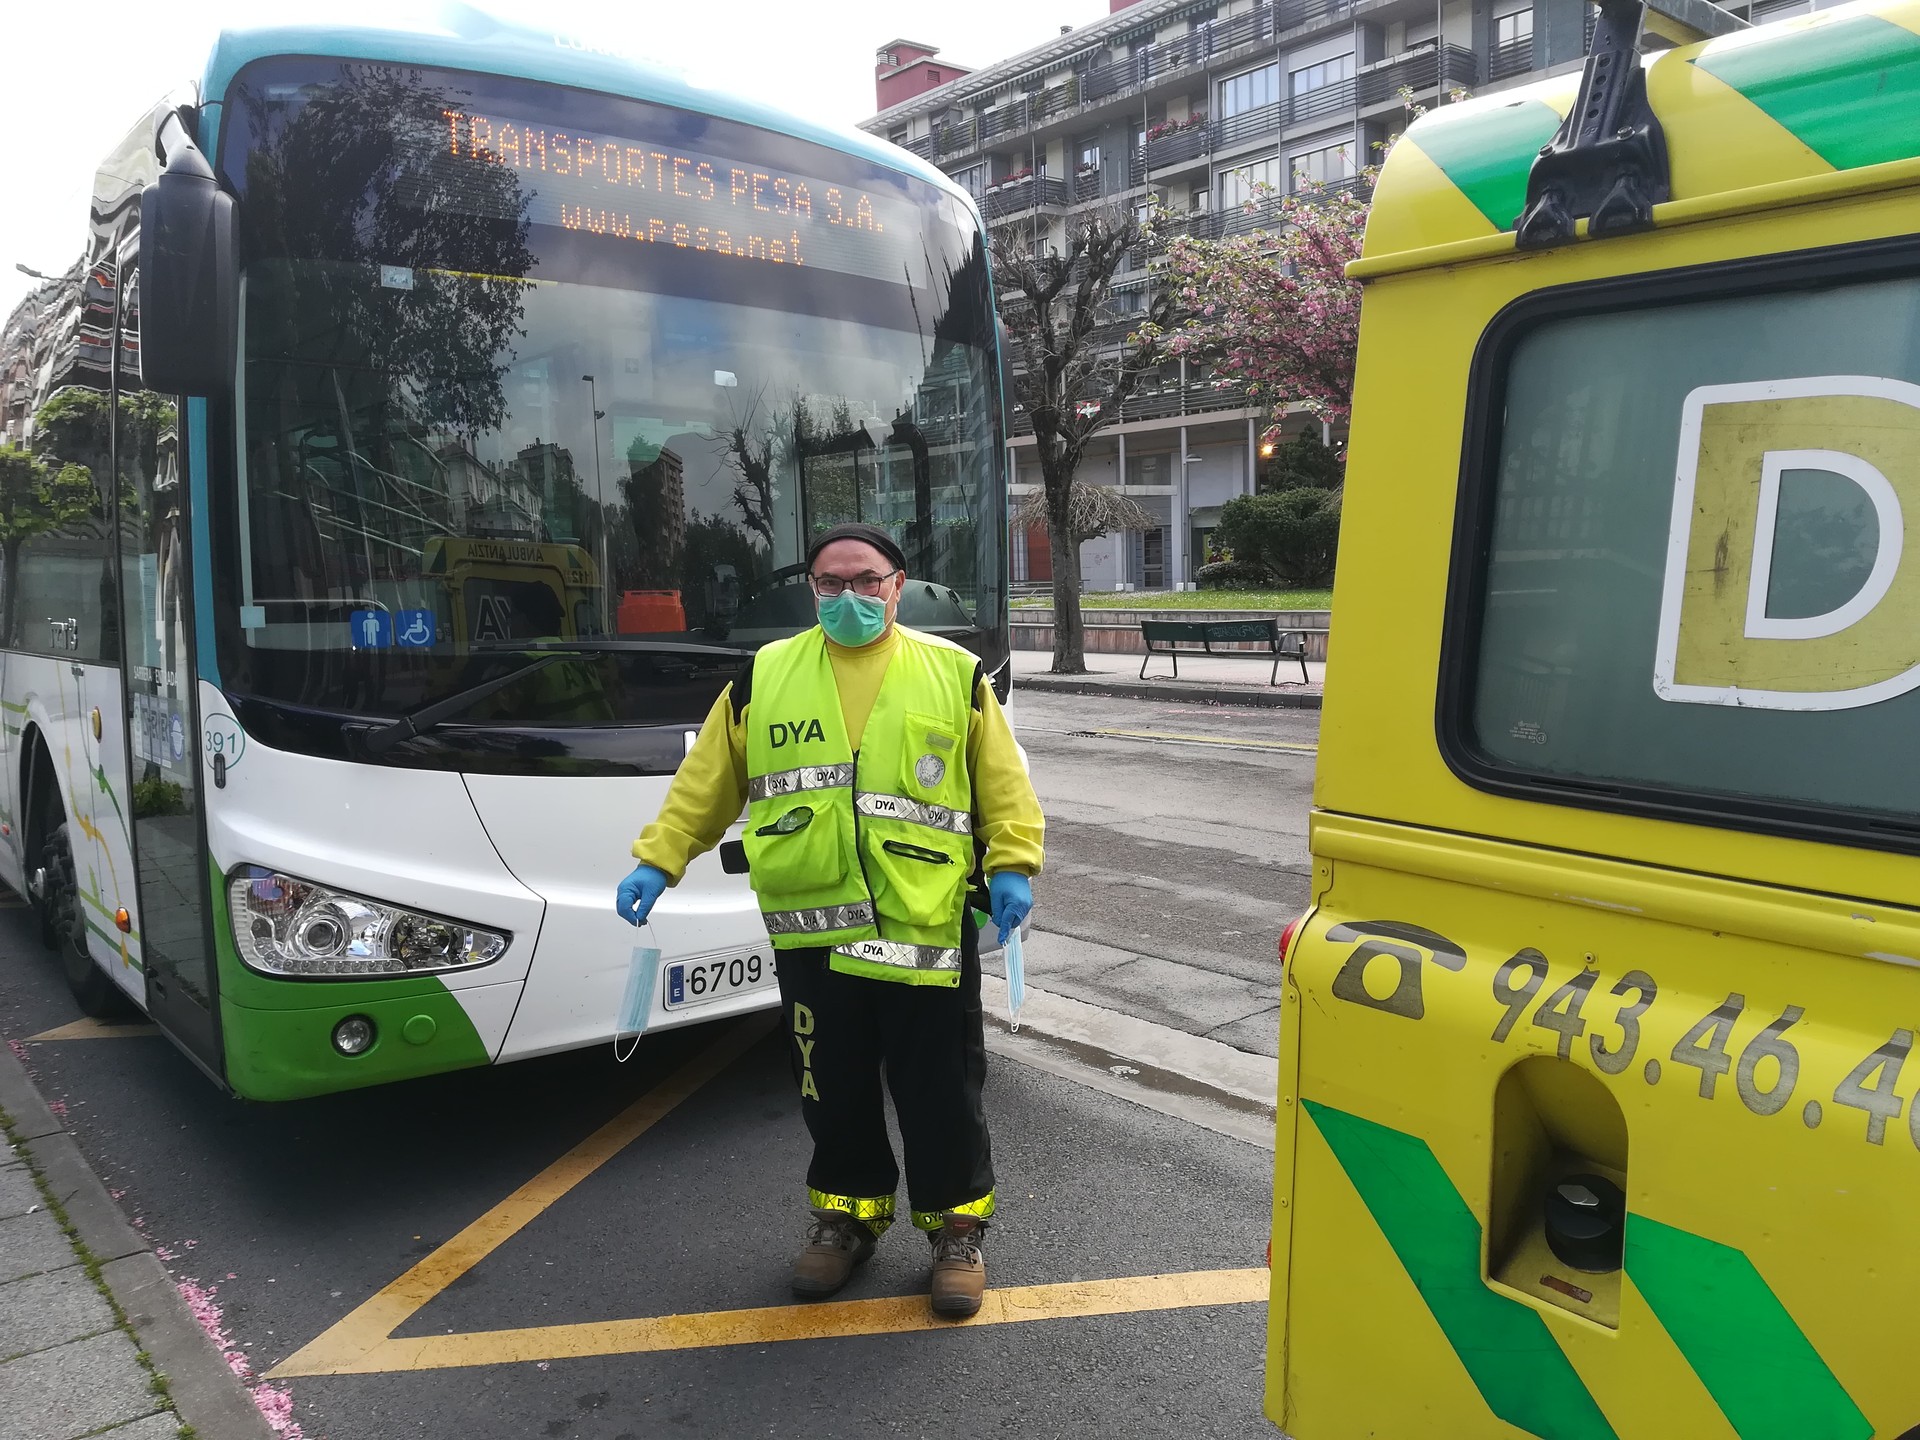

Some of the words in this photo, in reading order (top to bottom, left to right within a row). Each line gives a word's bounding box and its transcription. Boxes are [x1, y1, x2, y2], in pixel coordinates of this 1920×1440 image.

[443, 110, 715, 201] TRANSPORTES
[731, 168, 812, 219] PESA
[827, 188, 884, 232] S.A.
[561, 204, 804, 266] www.pesa.net
[769, 718, 826, 749] DYA
[205, 731, 237, 754] 391
[771, 777, 790, 789] DYA
[816, 771, 836, 782] DYA
[874, 800, 896, 811] DYA
[928, 810, 943, 821] DYA
[803, 916, 818, 926] DYA
[847, 909, 867, 920] DYA
[863, 943, 884, 956] DYA
[690, 954, 762, 995] 6709
[674, 987, 681, 997] E
[793, 1001, 820, 1102] DYA
[1491, 946, 1920, 1153] 943.46.4
[836, 1197, 857, 1214] DYA
